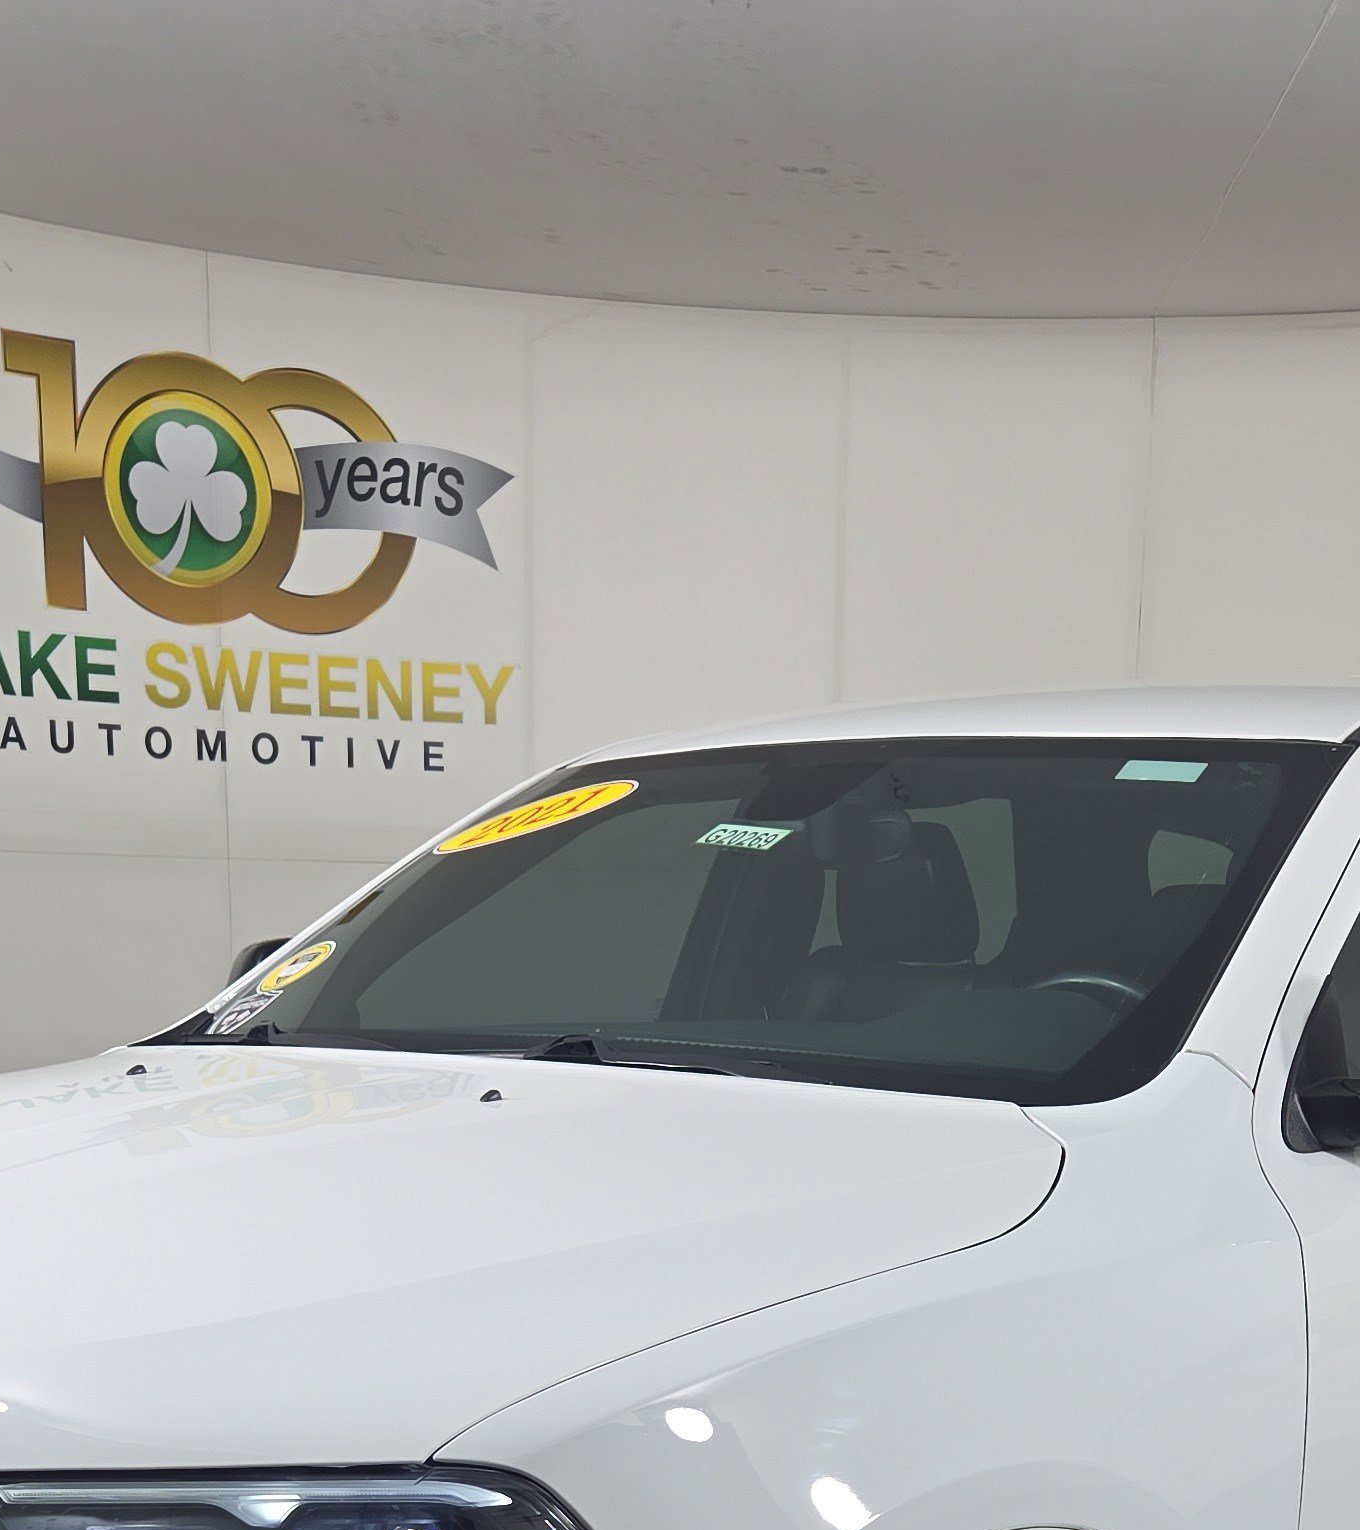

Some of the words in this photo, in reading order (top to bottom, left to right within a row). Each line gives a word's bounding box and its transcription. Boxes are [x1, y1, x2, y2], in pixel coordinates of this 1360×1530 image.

[314, 453, 466, 519] years
[143, 642, 516, 726] SWEENEY
[0, 716, 446, 772] AUTOMOTIVE
[459, 786, 611, 846] 2021
[704, 828, 780, 849] G20269
